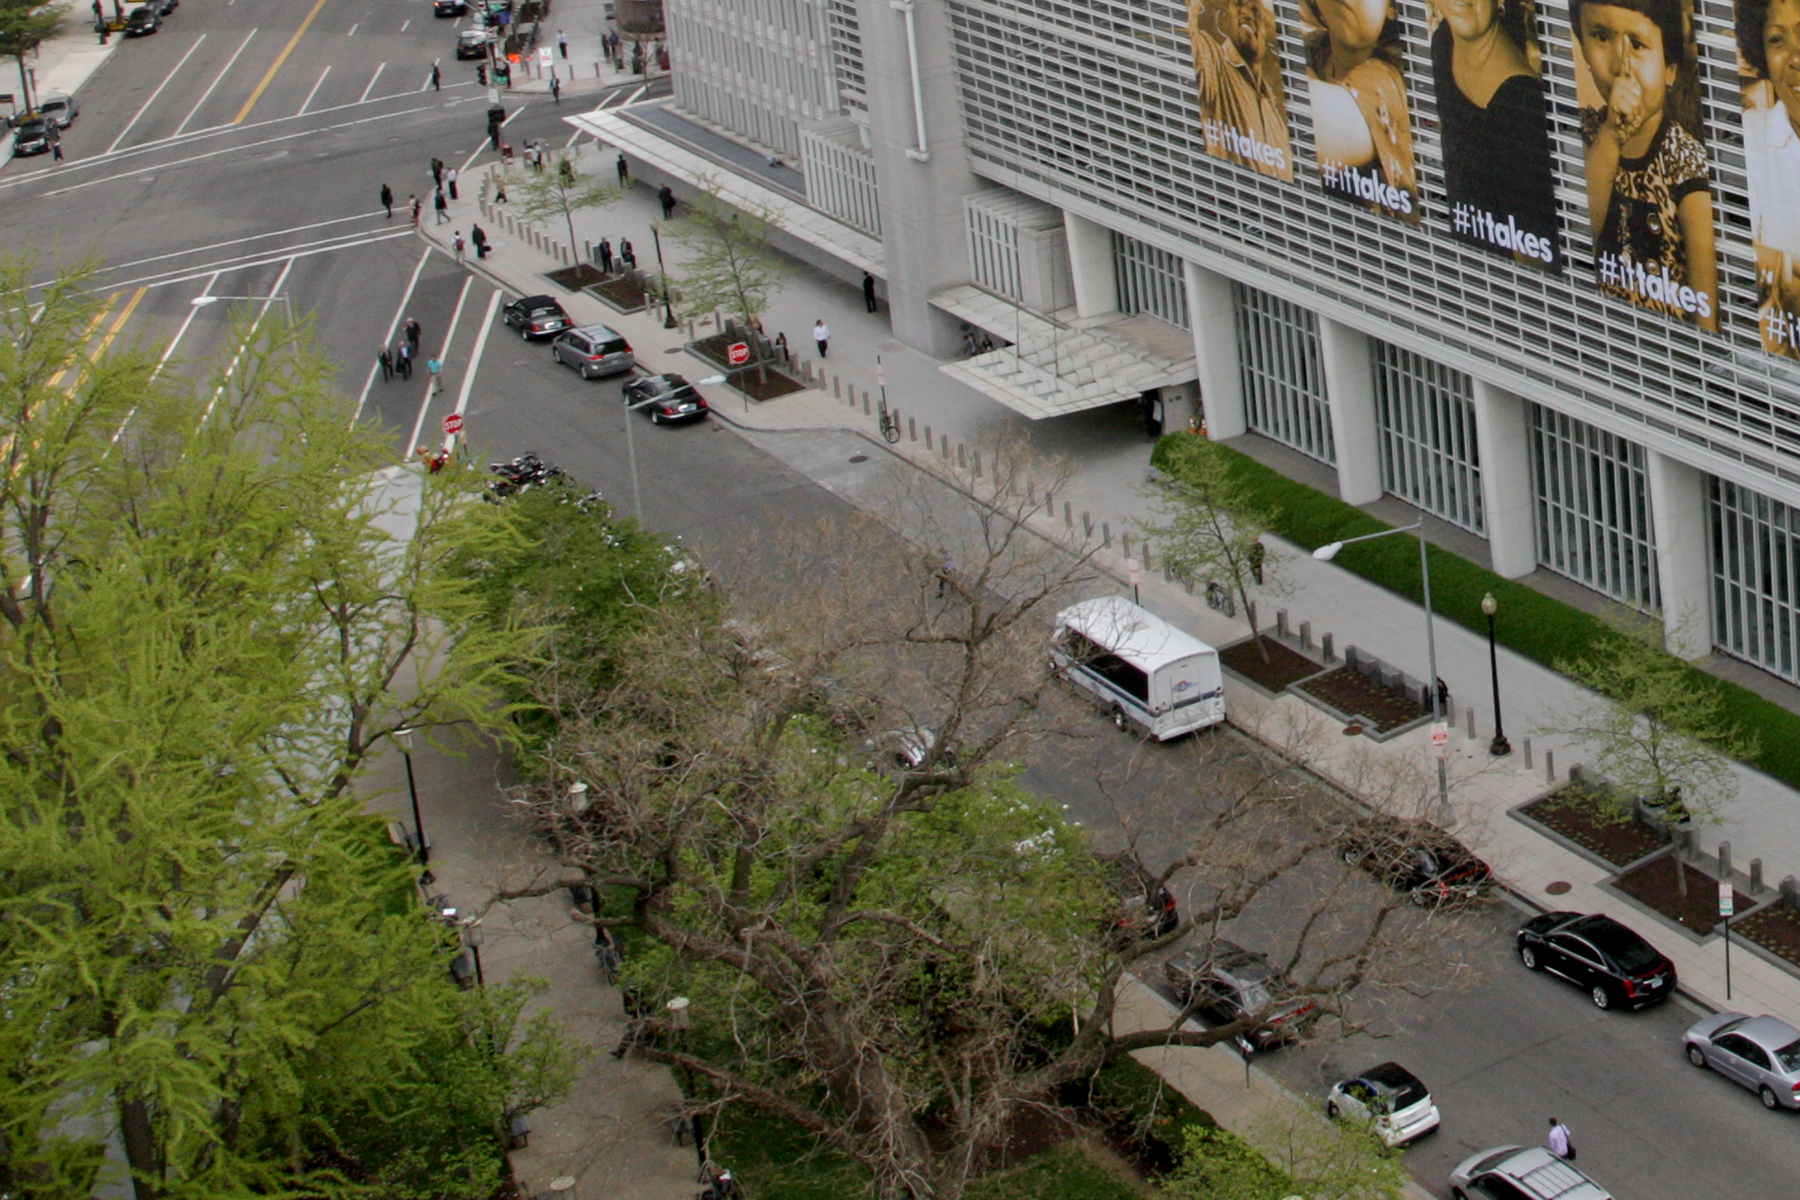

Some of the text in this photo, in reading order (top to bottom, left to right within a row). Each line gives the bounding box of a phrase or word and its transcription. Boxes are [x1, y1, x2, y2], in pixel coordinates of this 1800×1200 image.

[1205, 118, 1286, 171] #ittakes
[1322, 156, 1412, 216] #ittakes
[1452, 201, 1554, 263] #ittakes
[1598, 250, 1712, 318] #ittakes
[731, 347, 749, 359] STOP
[444, 418, 463, 430] STOP
